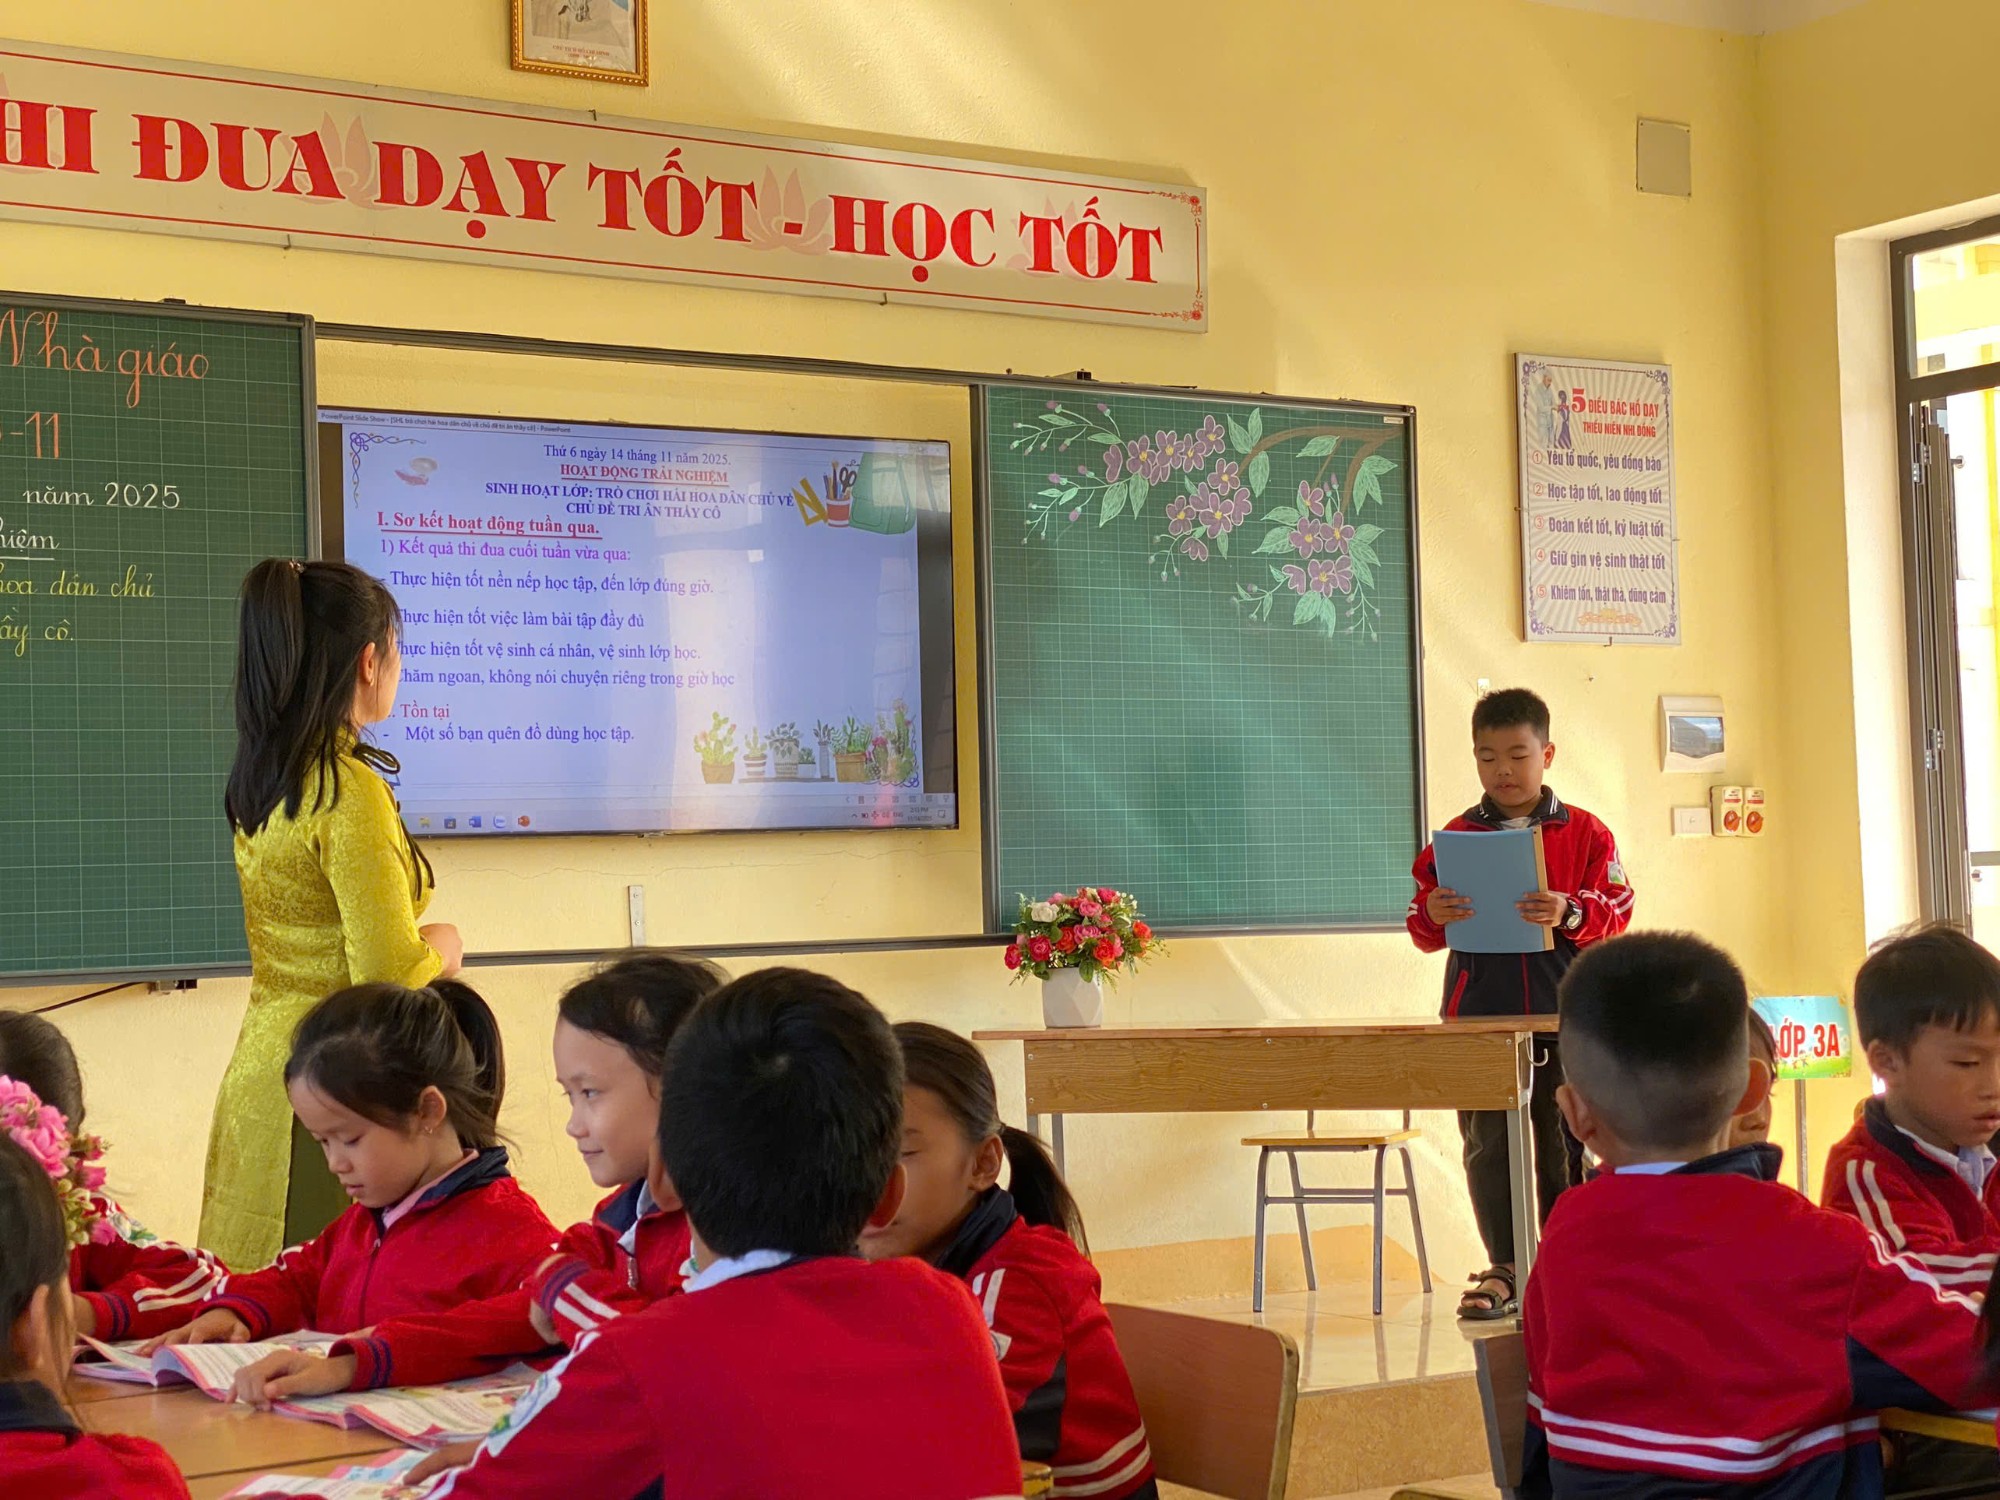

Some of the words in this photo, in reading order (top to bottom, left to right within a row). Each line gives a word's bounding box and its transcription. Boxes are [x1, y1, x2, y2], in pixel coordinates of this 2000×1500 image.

[132, 113, 347, 200] ĐUA
[371, 140, 567, 240] DẠY
[586, 146, 758, 243] TỐT
[829, 193, 998, 284] HỌC
[1019, 194, 1164, 285] TỐT
[0, 308, 110, 373] Nhà
[117, 341, 209, 409] giáo
[1571, 388, 1586, 413] 5
[1588, 397, 1608, 414] ĐIỀU
[1610, 398, 1627, 416] BÁC
[1629, 399, 1641, 417] HỒ
[1643, 403, 1659, 421] DẠY
[1583, 419, 1603, 434] THIẾU
[1604, 421, 1622, 435] NIÊN
[1623, 423, 1636, 436] NHI
[543, 444, 567, 457] Thứ
[570, 446, 577, 458] 6
[580, 447, 606, 462] ngày
[611, 448, 624, 460] 14
[627, 449, 657, 464] tháng
[661, 450, 672, 463] 11
[676, 451, 699, 464] năm
[702, 452, 732, 466] 2025.
[1547, 449, 1564, 466] Yêu
[1577, 450, 1602, 469] quốc,
[1604, 453, 1620, 470] yêu
[1645, 455, 1662, 471] bào
[560, 463, 598, 479] HOẠT
[600, 465, 639, 480] ĐỘNG
[641, 466, 672, 480] TRẢI
[675, 470, 728, 485] NGHIỆM
[22, 485, 95, 507] năm
[104, 481, 181, 509] 2025
[485, 482, 518, 495] SINH
[521, 484, 560, 499] HOẠT
[562, 483, 593, 498] LỚP:
[595, 485, 624, 499] TRÒ
[626, 488, 660, 501] CHƠI
[689, 491, 717, 503] HOA
[719, 490, 745, 504] DÂN
[748, 491, 776, 505] CHỦ
[1547, 483, 1567, 501] Học
[1569, 484, 1585, 502] tập
[1587, 483, 1603, 502] tốt,
[1606, 486, 1621, 502] lao
[1623, 487, 1647, 506] động
[1649, 486, 1662, 504] tốt
[566, 500, 594, 514] CHỦ
[598, 502, 616, 515] ĐỀ
[618, 504, 640, 516] TRI
[643, 502, 662, 517] ÂN
[702, 505, 721, 519] CÔ
[377, 511, 389, 526] I.
[393, 511, 415, 527] Sơ
[419, 509, 444, 528] kết
[448, 514, 482, 534] hoạt
[487, 515, 525, 535] động
[529, 514, 563, 533] tuần
[567, 522, 600, 537] qua.
[1548, 516, 1575, 533] Đoàn
[1577, 516, 1594, 534] kết
[1596, 517, 1612, 536] tốt,
[1629, 520, 1648, 539] luật
[1650, 520, 1664, 537] tốt
[380, 539, 394, 556] 1)
[399, 536, 425, 554] Kết
[428, 540, 454, 558] quả
[457, 541, 475, 556] thi
[480, 542, 505, 557] đua
[508, 540, 538, 558] cuối
[542, 541, 571, 559] tuần
[574, 545, 599, 560] vừa
[603, 549, 631, 564] qua:
[1550, 550, 1568, 566] Giữ
[1589, 552, 1602, 570] vệ
[1604, 553, 1627, 568] sinh
[1629, 553, 1649, 572] thật
[1652, 552, 1666, 570] tốt
[50, 569, 99, 596] dân
[110, 564, 156, 598] chủ
[390, 570, 427, 589] Thực
[431, 571, 461, 589] hiện
[465, 568, 484, 587] tốt
[488, 569, 512, 588] nền
[516, 570, 541, 592] nếp
[545, 574, 569, 590] học
[573, 575, 597, 593] tập,
[601, 573, 625, 591] đến
[629, 577, 650, 595] lớp
[653, 578, 686, 595] đúng
[689, 579, 714, 596] giờ.
[1551, 585, 1576, 600] Khiêm
[44, 618, 74, 641] cô.
[434, 608, 464, 626] hiện
[467, 606, 486, 625] tốt
[490, 610, 518, 627] việc
[523, 611, 548, 626] làm
[552, 611, 573, 626] bài
[576, 612, 597, 630] tập
[600, 609, 624, 630] đầy
[627, 613, 645, 628] đủ
[430, 641, 461, 658] hiện
[465, 638, 483, 656] tốt
[487, 642, 503, 659] vệ
[507, 642, 536, 657] sinh
[539, 643, 555, 657] cá
[558, 643, 595, 660] nhân,
[599, 644, 615, 660] vệ
[618, 644, 645, 659] sinh
[650, 644, 671, 662] lớp
[674, 645, 701, 661] học.
[438, 671, 485, 686] ngoan,
[489, 669, 532, 687] không
[535, 669, 557, 684] nói
[561, 669, 609, 687] chuyện
[612, 670, 647, 688] riêng
[650, 672, 684, 688] trong
[687, 671, 709, 688] giờ
[712, 671, 735, 688] học
[400, 700, 429, 718] Tồn
[433, 704, 450, 720] tại
[405, 726, 435, 743] Một
[439, 722, 454, 741] số
[458, 726, 483, 743] bạn
[488, 729, 520, 744] quên
[524, 722, 542, 740] đồ
[545, 726, 580, 743] dùng
[583, 726, 607, 743] học
[611, 726, 634, 743] tập.
[1768, 1018, 1806, 1059] ỚP
[1813, 1023, 1840, 1058] 3A
